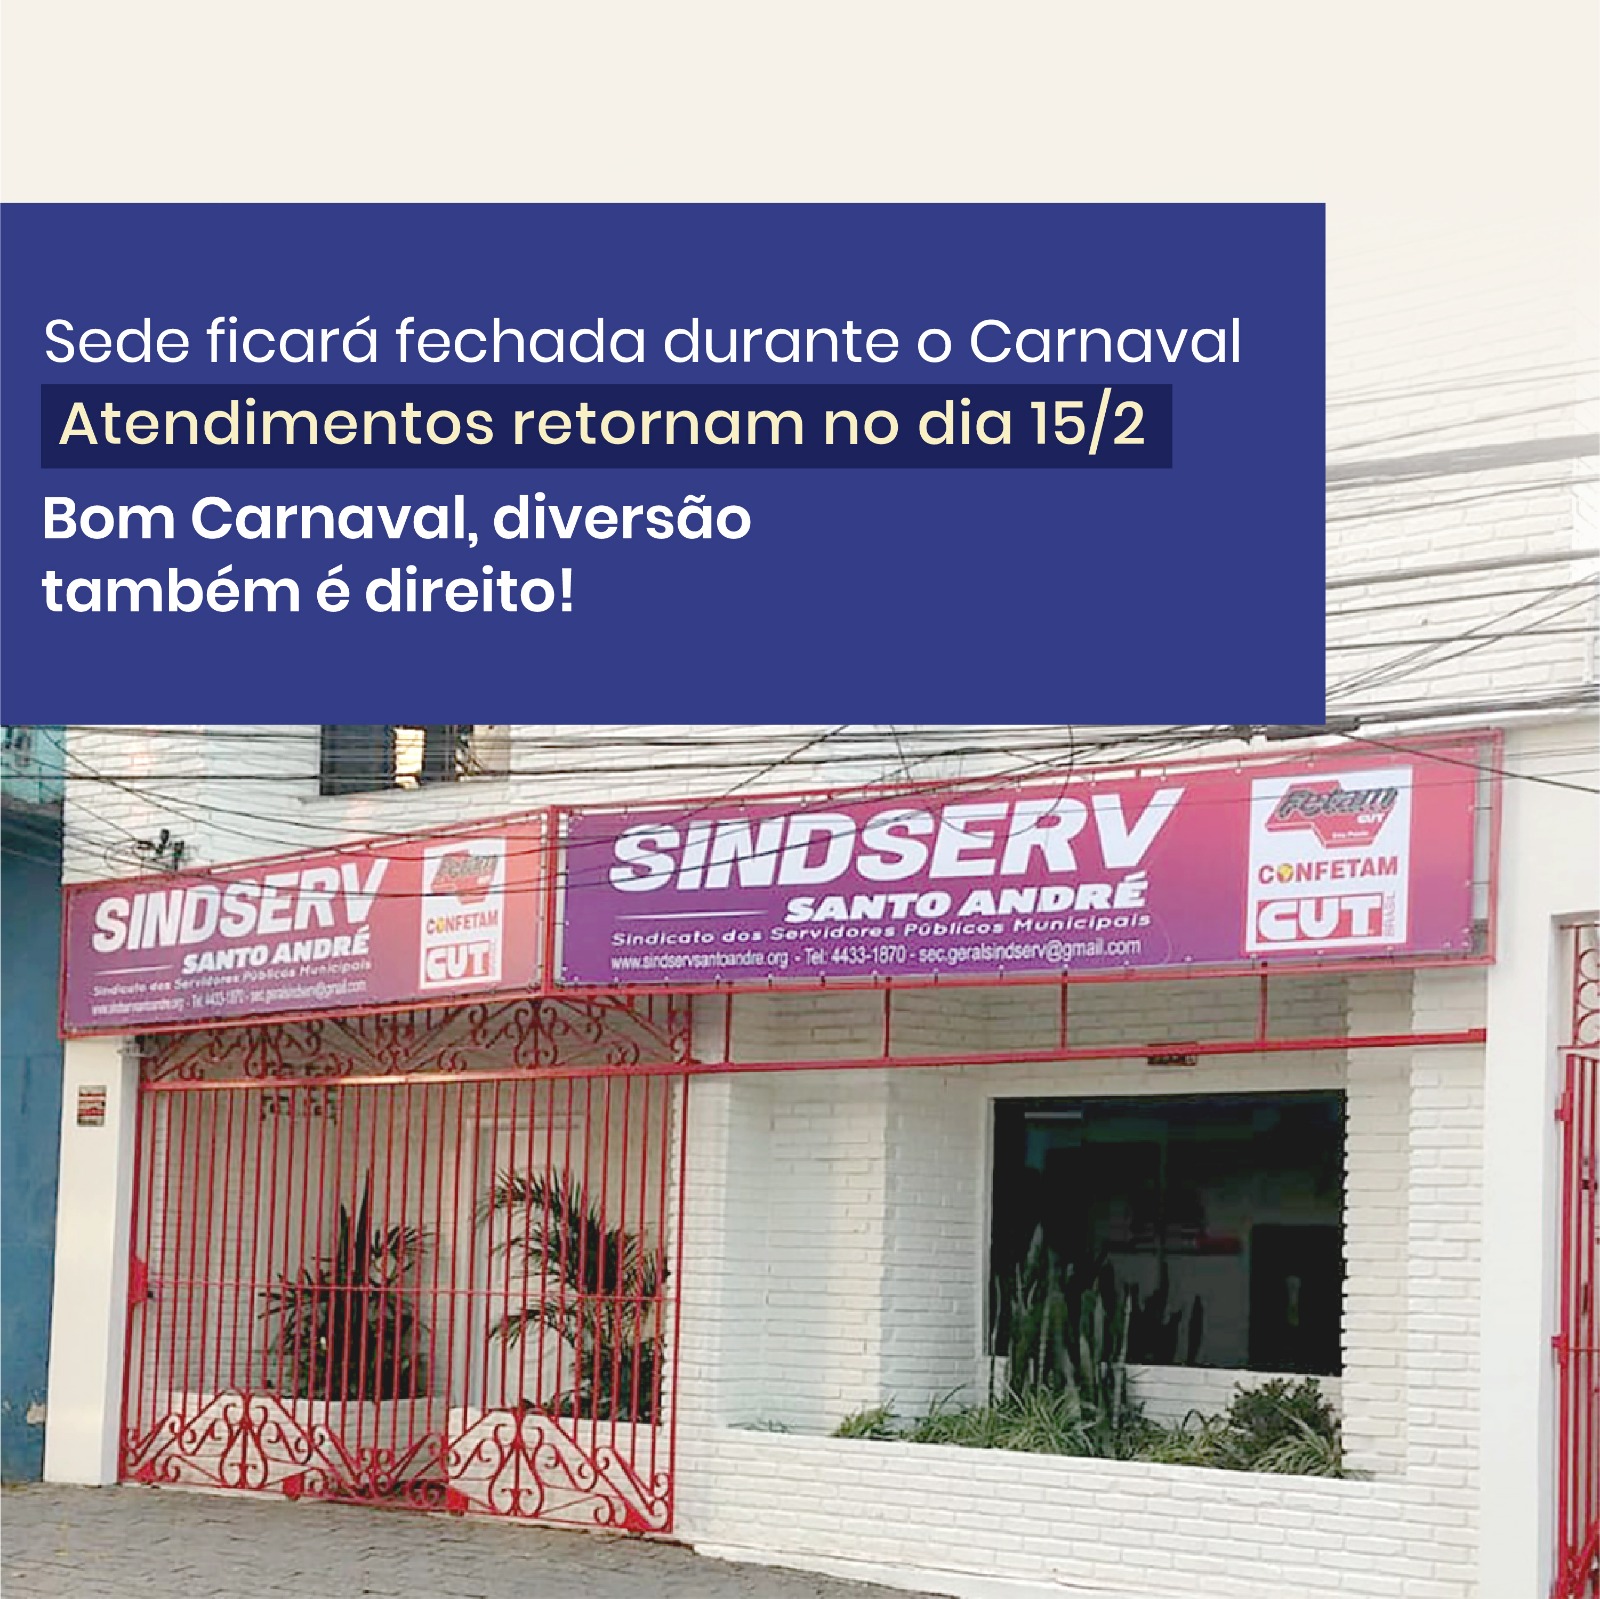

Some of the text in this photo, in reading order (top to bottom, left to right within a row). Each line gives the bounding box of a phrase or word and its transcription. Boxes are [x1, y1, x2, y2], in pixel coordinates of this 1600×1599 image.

[609, 788, 1184, 893] SINDSERV
[1258, 856, 1398, 885] CONFETAM
[91, 858, 389, 954] SINDSERV
[784, 871, 1148, 924] SANTO ANDRÉ
[1258, 894, 1383, 942] CUT
[426, 910, 498, 935] CONFETAM
[611, 914, 1151, 947] Sindicato dos Servidores Públicos Municipais
[181, 924, 371, 975] SANTO ANDRÉ
[426, 941, 491, 981] CUT
[831, 945, 906, 965] 4433-1870
